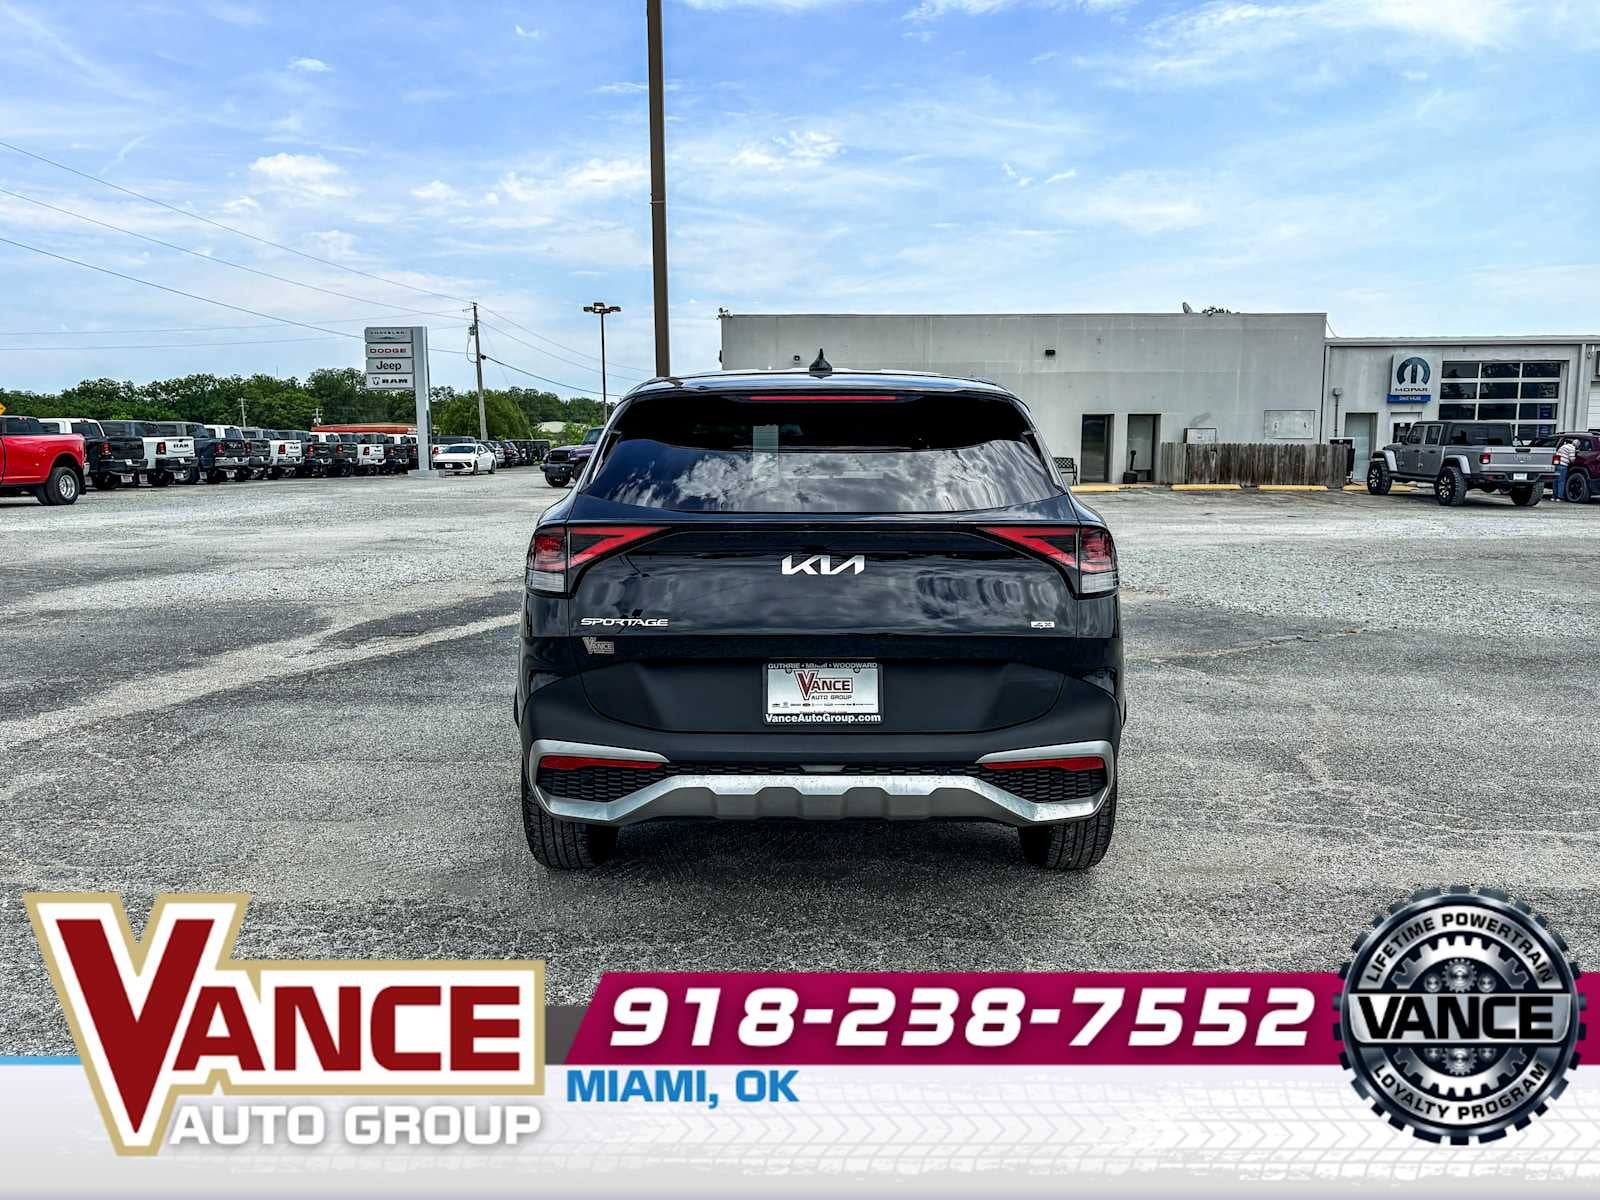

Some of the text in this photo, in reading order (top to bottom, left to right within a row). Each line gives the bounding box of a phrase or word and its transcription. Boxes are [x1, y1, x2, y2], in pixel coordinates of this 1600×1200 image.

[376, 361, 402, 371] Jeep
[782, 554, 865, 575] KIA
[580, 617, 670, 627] SPORTAGE
[795, 671, 851, 699] VANCE
[765, 713, 881, 723] VanceAutoGroup.com
